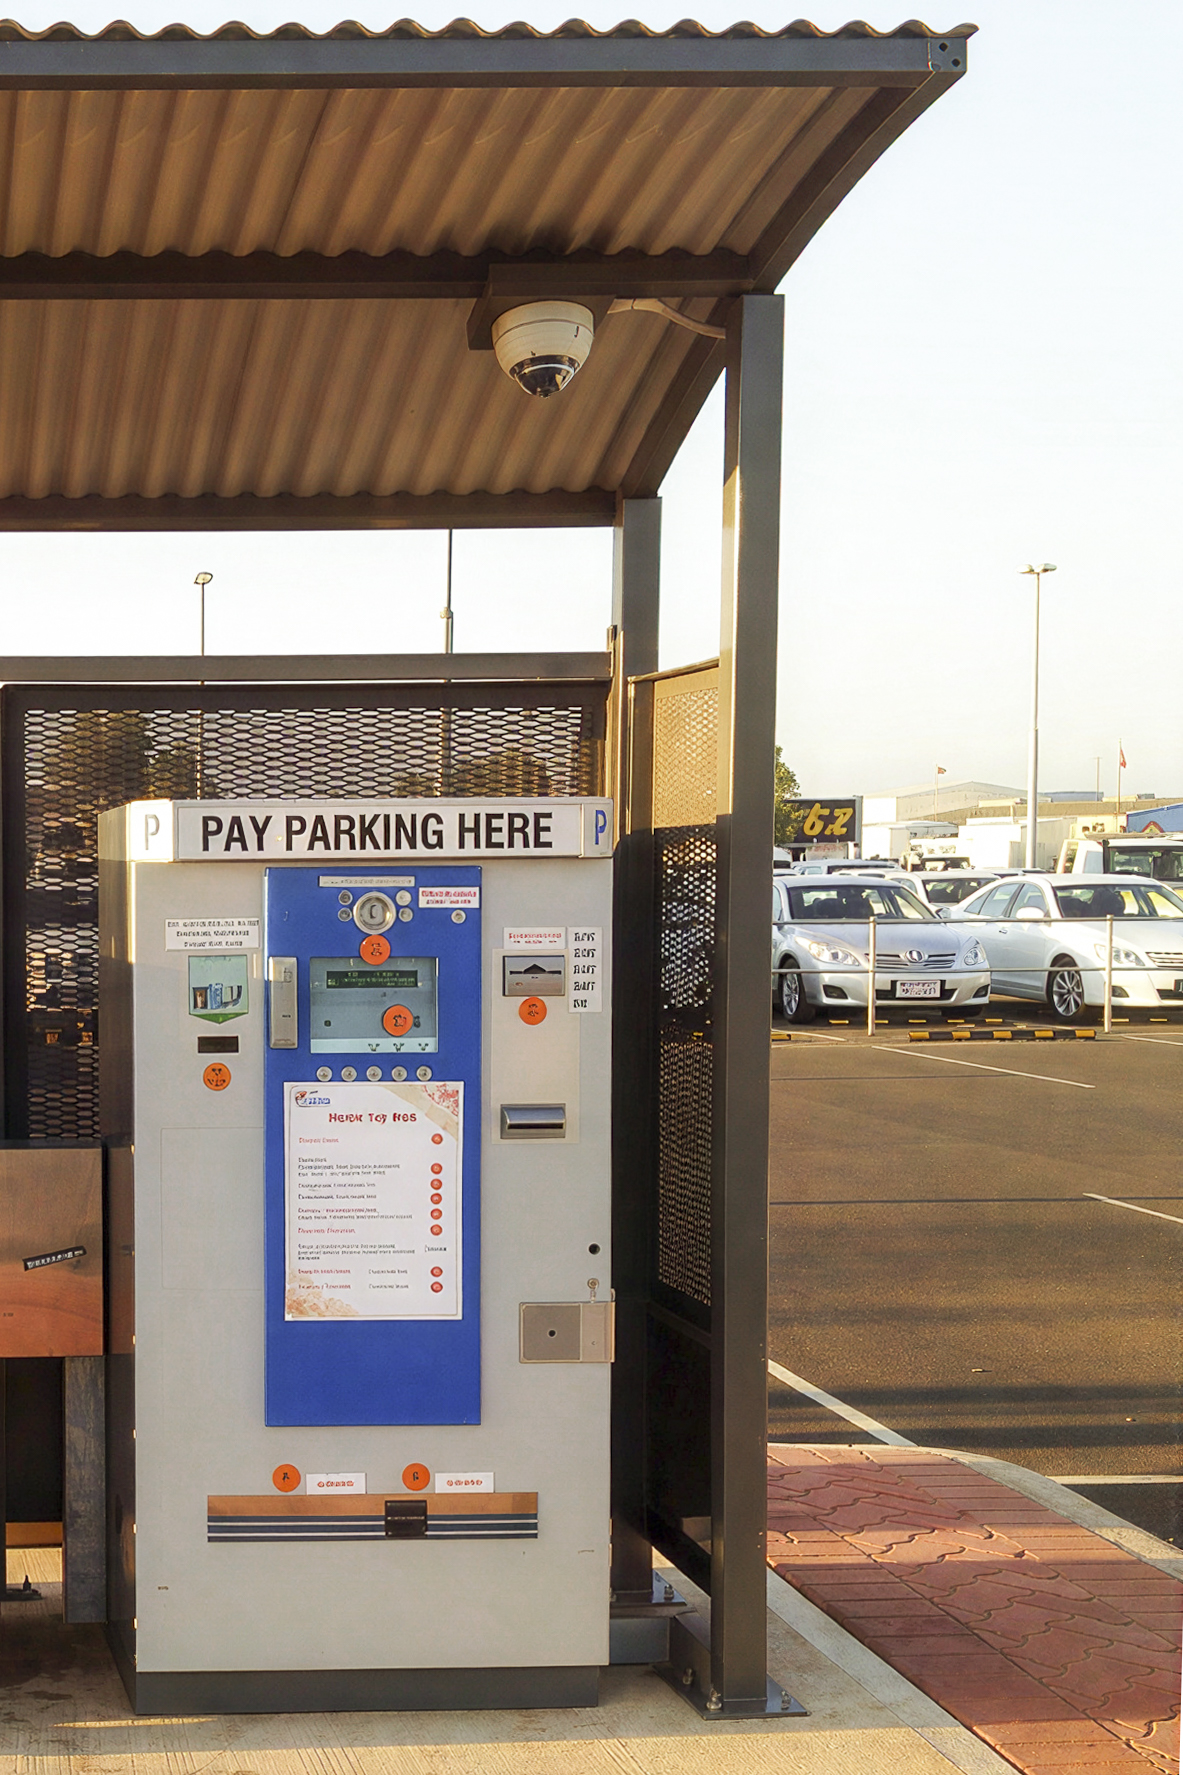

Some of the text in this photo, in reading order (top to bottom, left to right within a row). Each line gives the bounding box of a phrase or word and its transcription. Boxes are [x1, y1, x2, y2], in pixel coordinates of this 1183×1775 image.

[144, 814, 160, 851] P
[202, 812, 553, 852] PAY PARKING HERE
[594, 809, 607, 845] P
